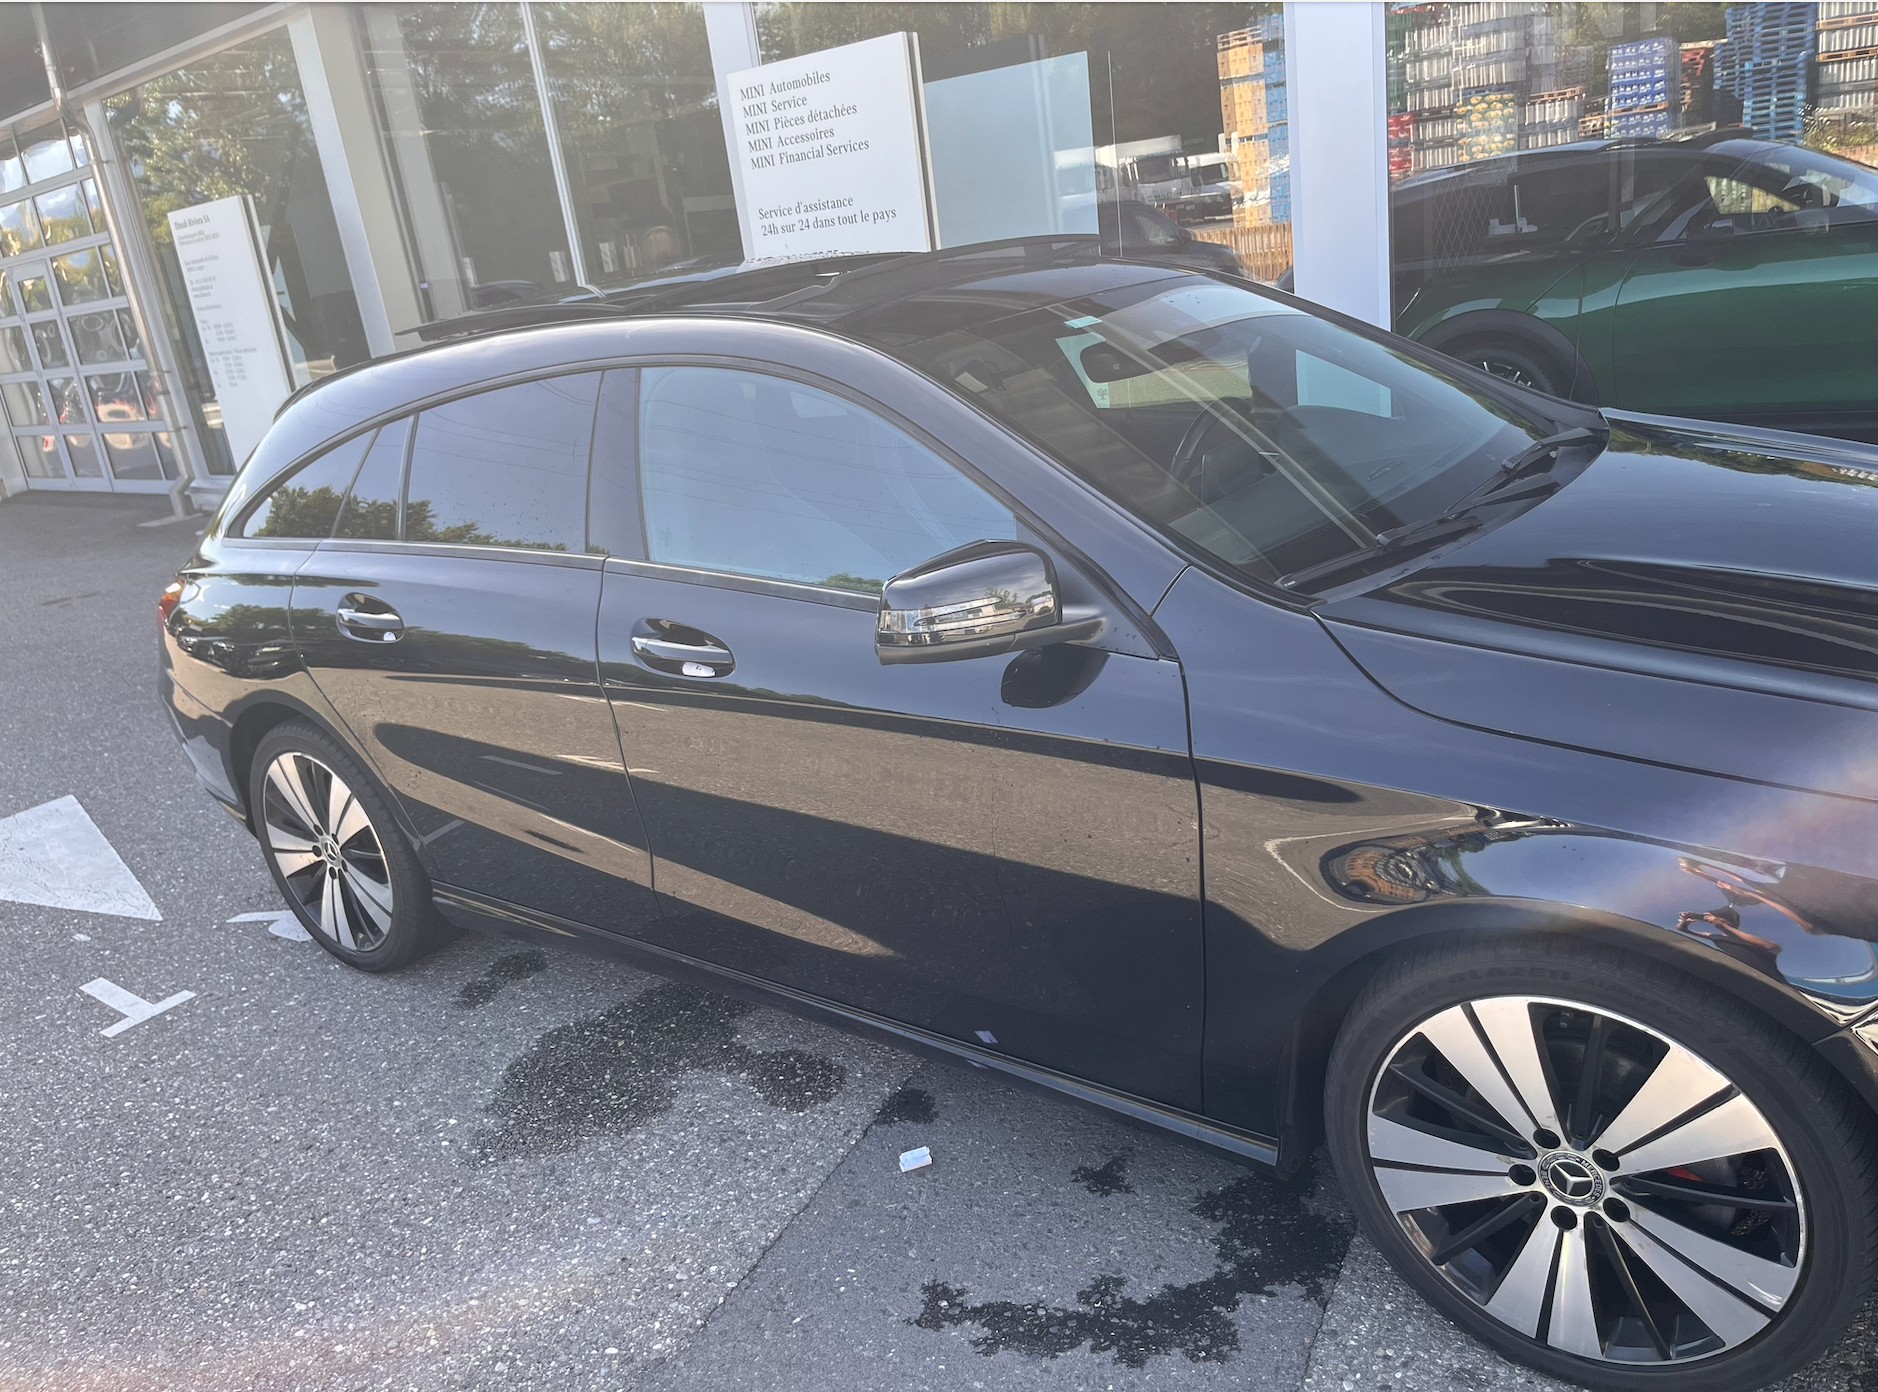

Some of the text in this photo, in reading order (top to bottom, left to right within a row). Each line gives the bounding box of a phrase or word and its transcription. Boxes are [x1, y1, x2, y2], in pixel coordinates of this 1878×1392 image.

[740, 71, 831, 101] MINI Automobiles
[743, 95, 808, 118] MINI Service
[745, 103, 858, 136] MINI Pièces détachées
[748, 127, 835, 153] MINI Accessoires
[751, 139, 870, 170] MINI Financial Services
[758, 197, 854, 220] Service d'assistance
[761, 208, 897, 237] 24h sur 24 dans tout le pays
[1540, 1170, 1553, 1190] BENZ
[1580, 1159, 1603, 1198] MERCEDES
